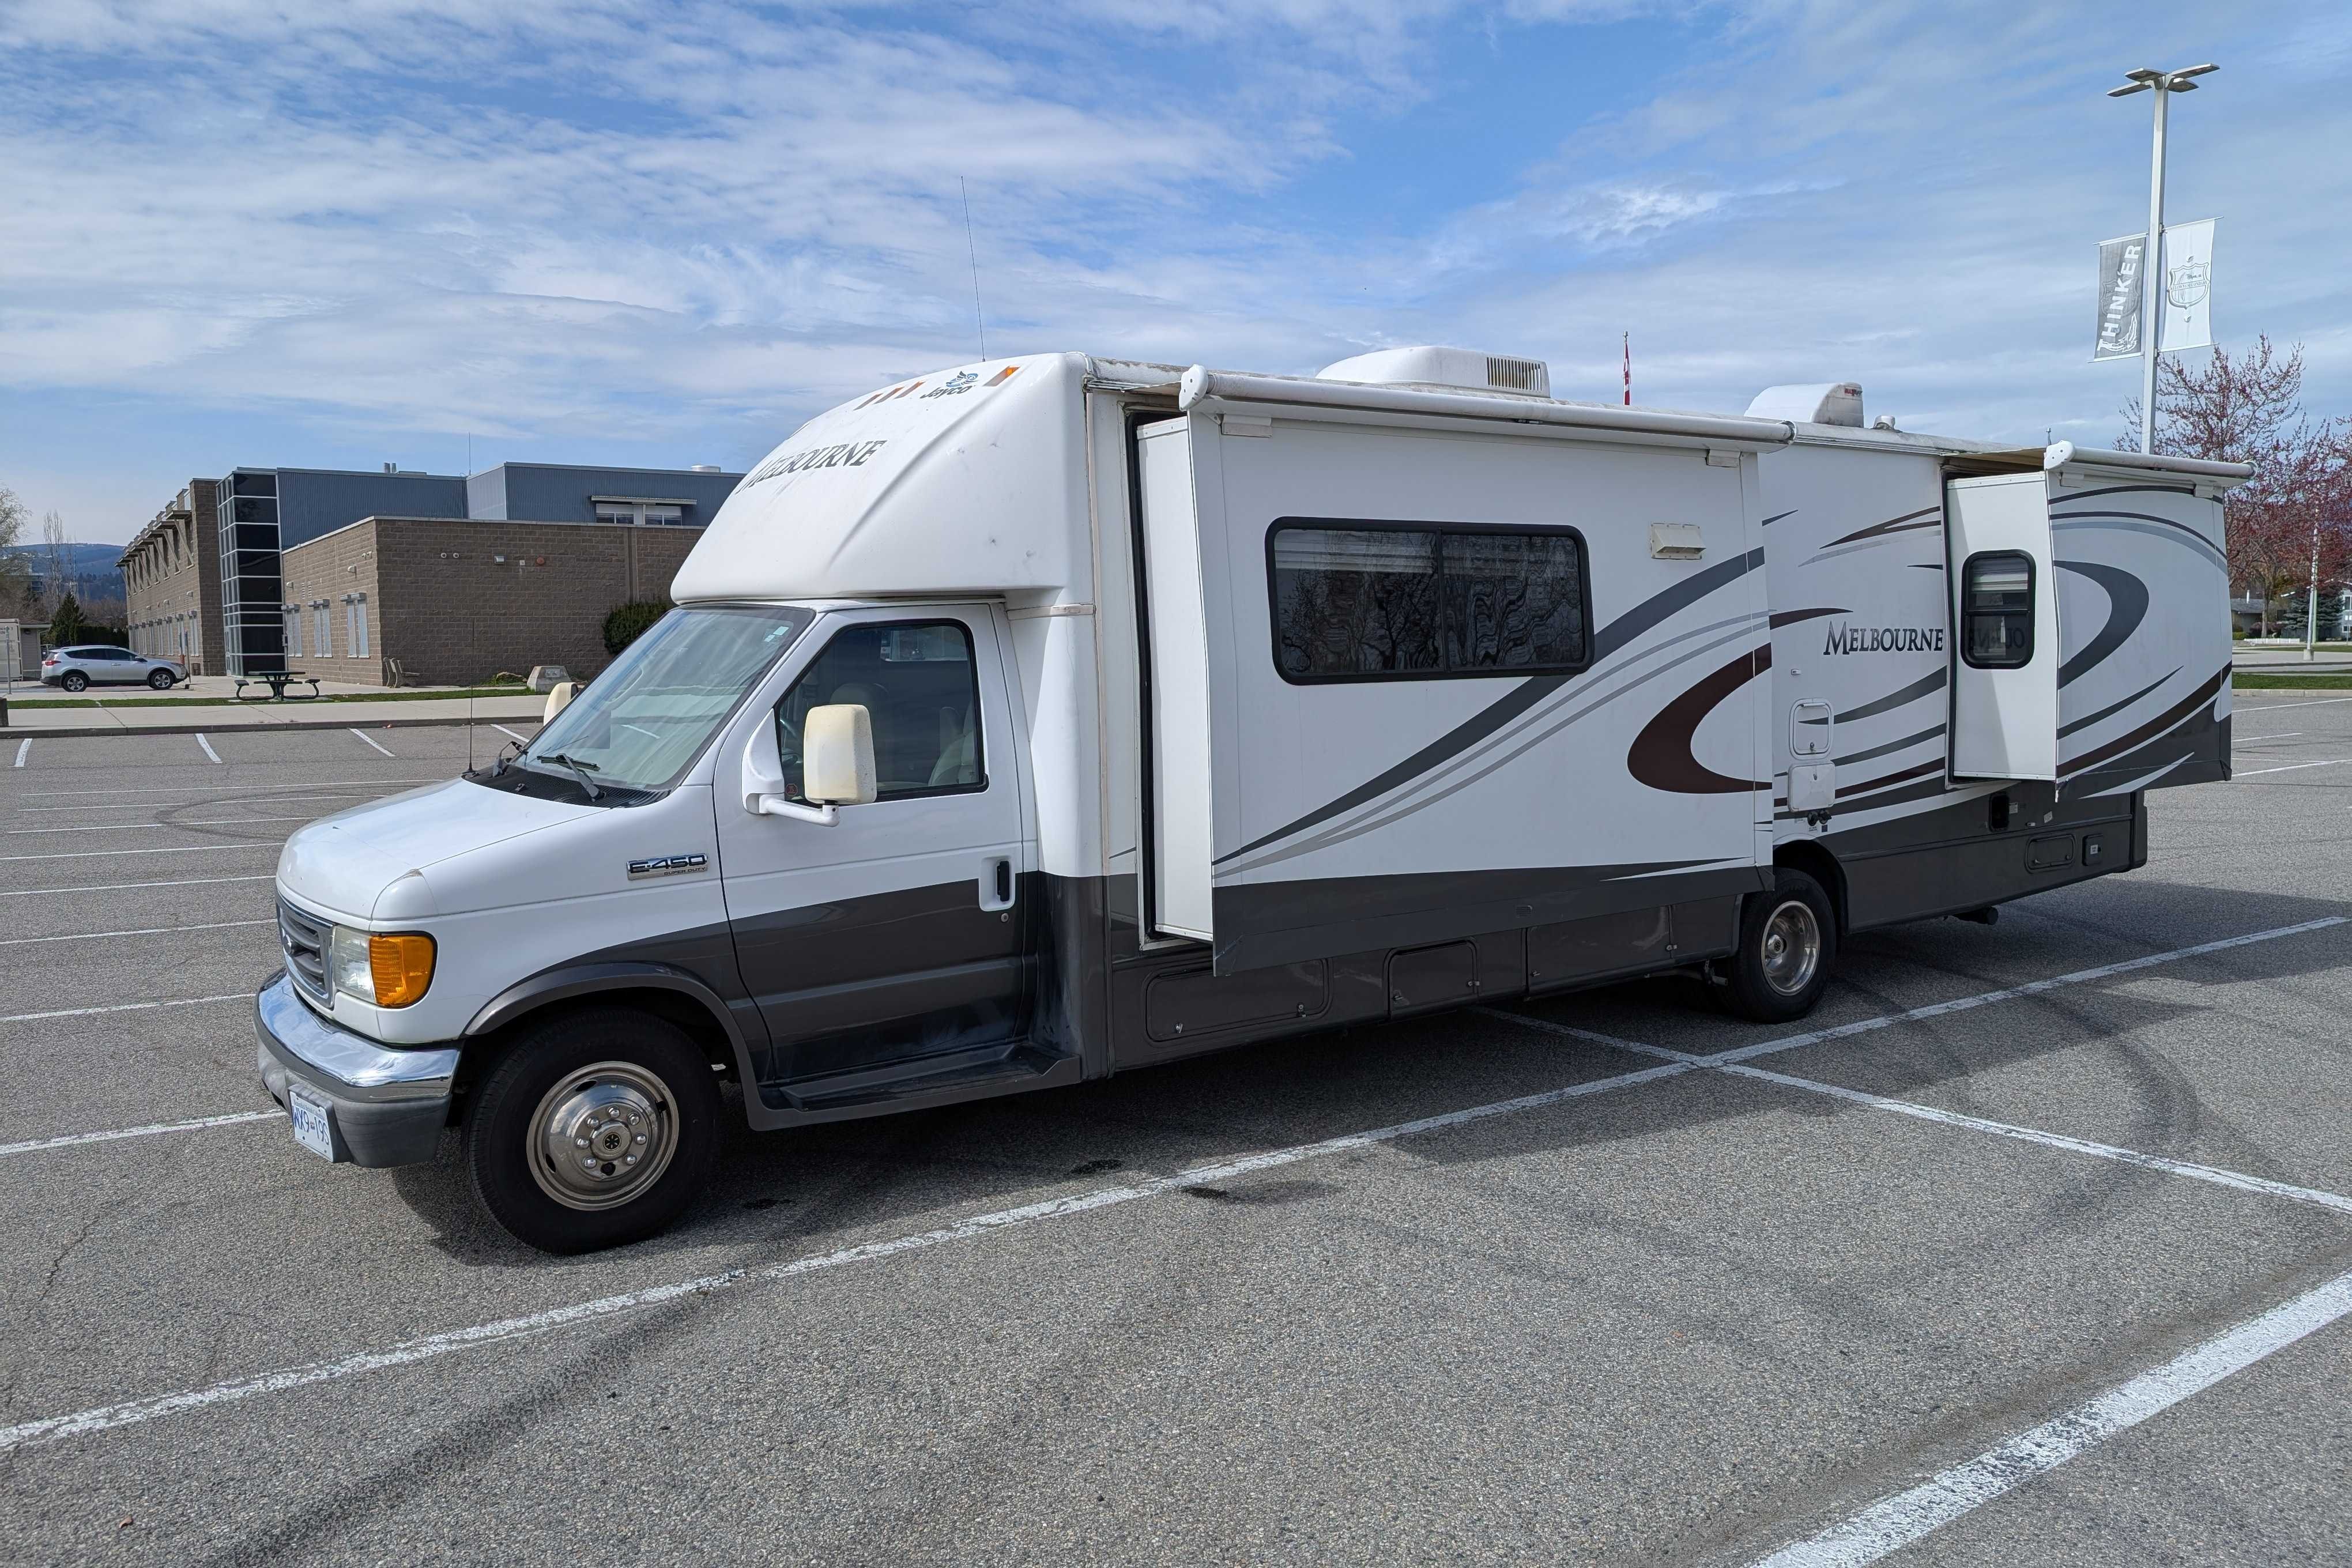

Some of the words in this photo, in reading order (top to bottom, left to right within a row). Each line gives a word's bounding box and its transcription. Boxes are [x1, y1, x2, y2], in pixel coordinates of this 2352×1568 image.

[2097, 244, 2142, 351] THINKER
[919, 385, 973, 399] Jayco
[734, 440, 888, 495] MELBOURNE
[1823, 620, 1944, 655] MELBOURNE
